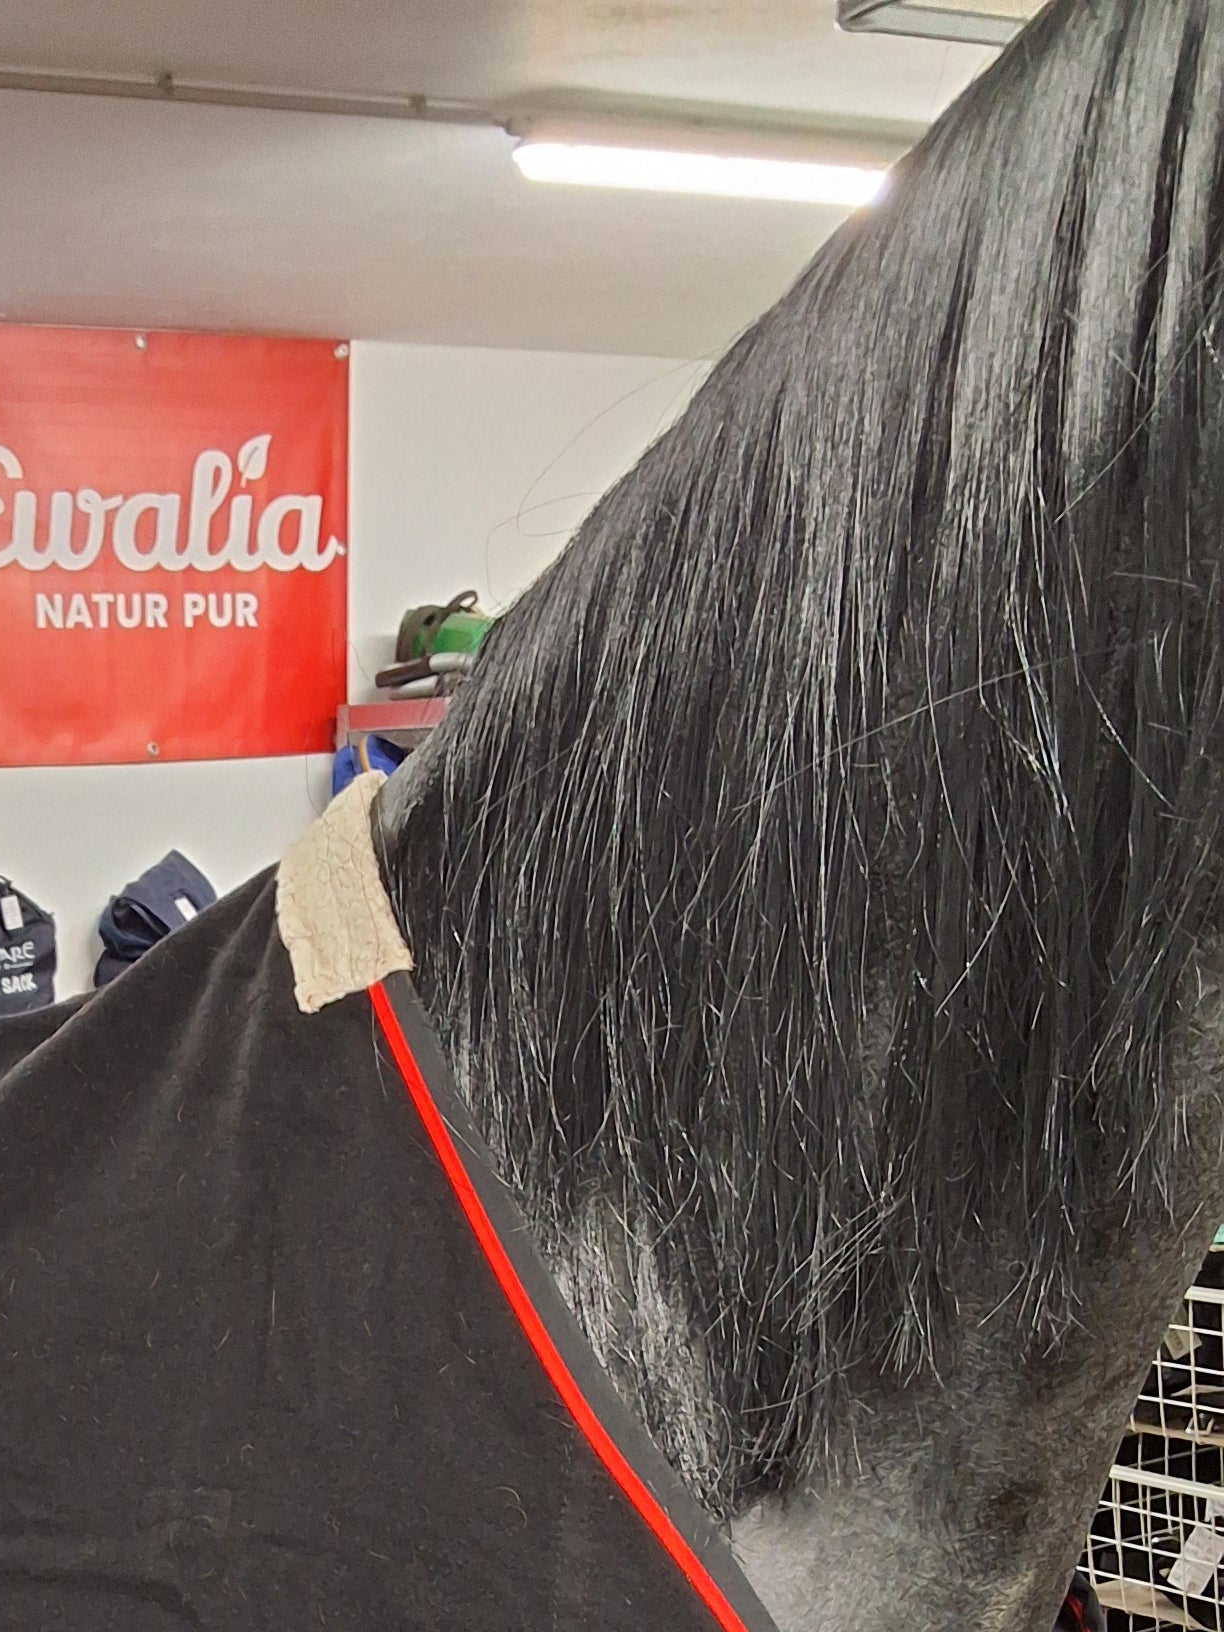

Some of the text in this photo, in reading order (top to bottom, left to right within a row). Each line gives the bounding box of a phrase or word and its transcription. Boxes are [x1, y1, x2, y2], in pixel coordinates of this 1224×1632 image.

[36, 592, 259, 629] NATUR PUR
[1, 972, 37, 994] SACK
